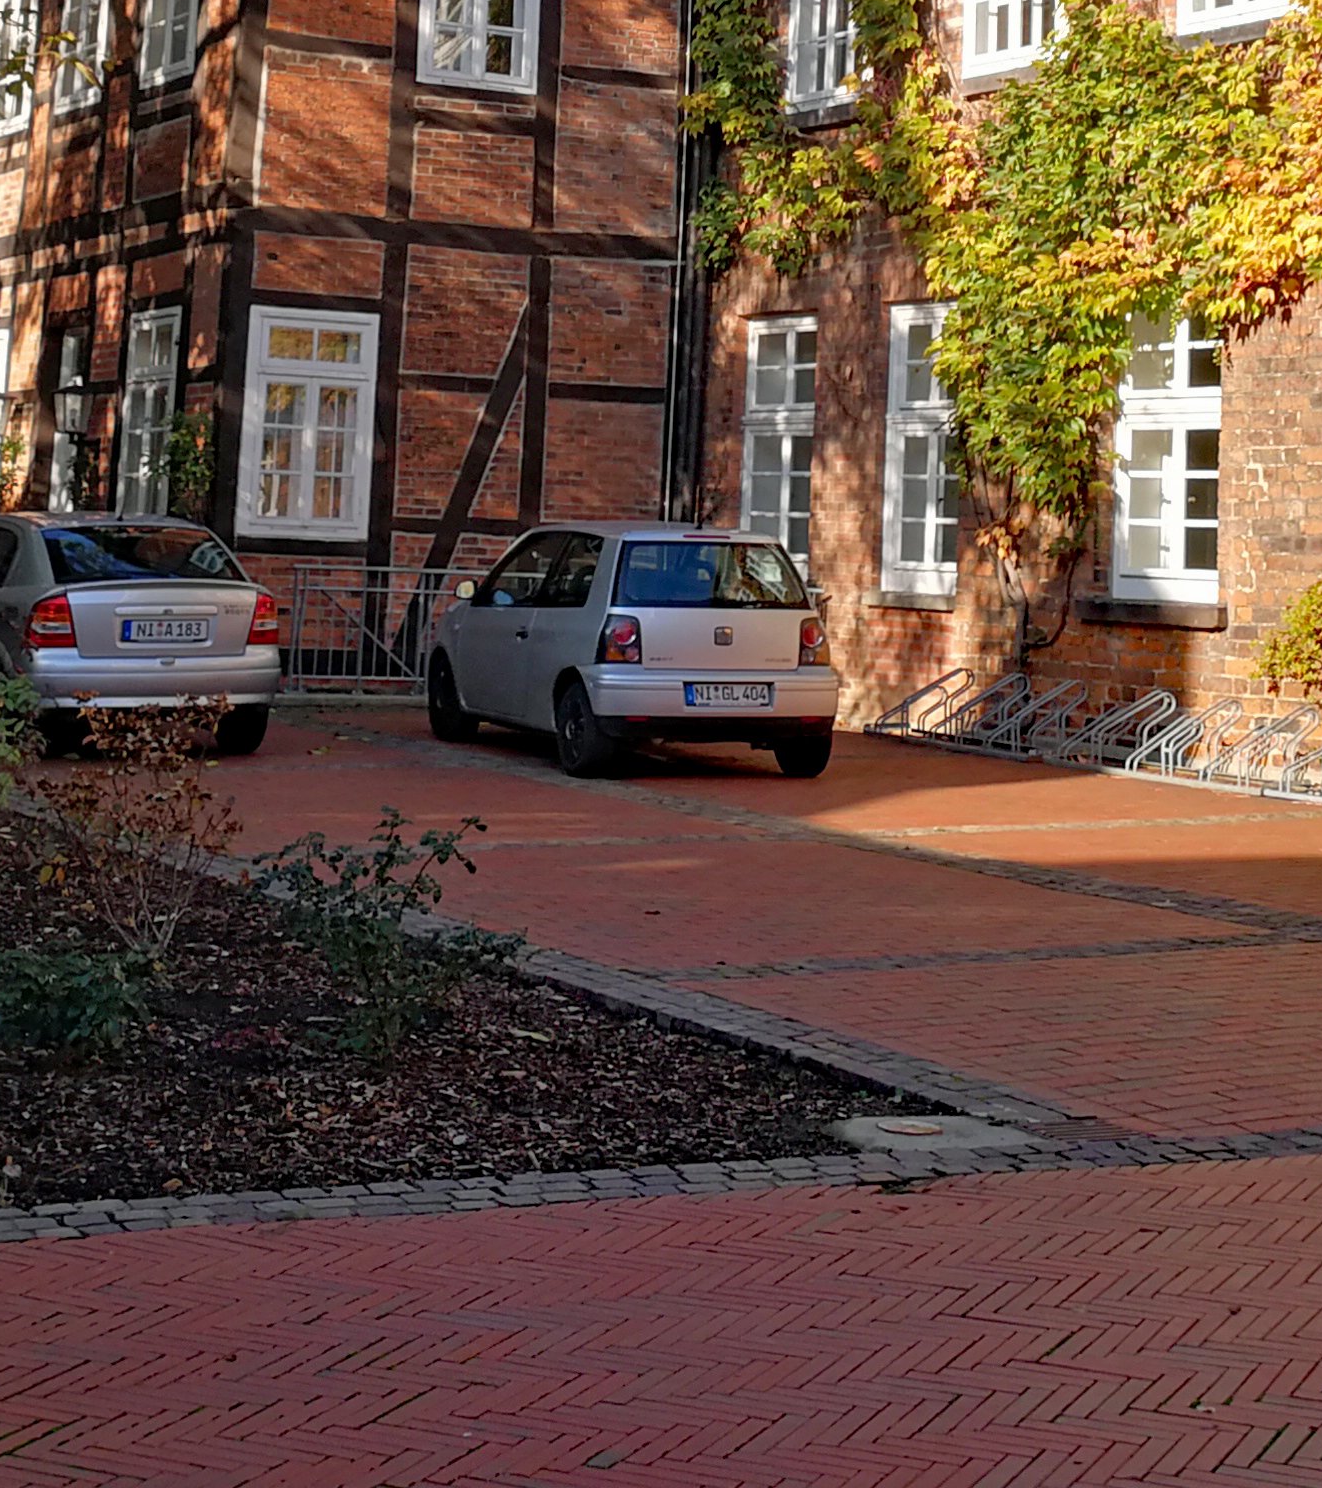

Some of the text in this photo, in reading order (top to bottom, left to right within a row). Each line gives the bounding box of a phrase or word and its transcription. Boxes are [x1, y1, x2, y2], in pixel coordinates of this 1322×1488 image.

[136, 622, 202, 637] NI A 183
[695, 686, 767, 701] NI GL 404
